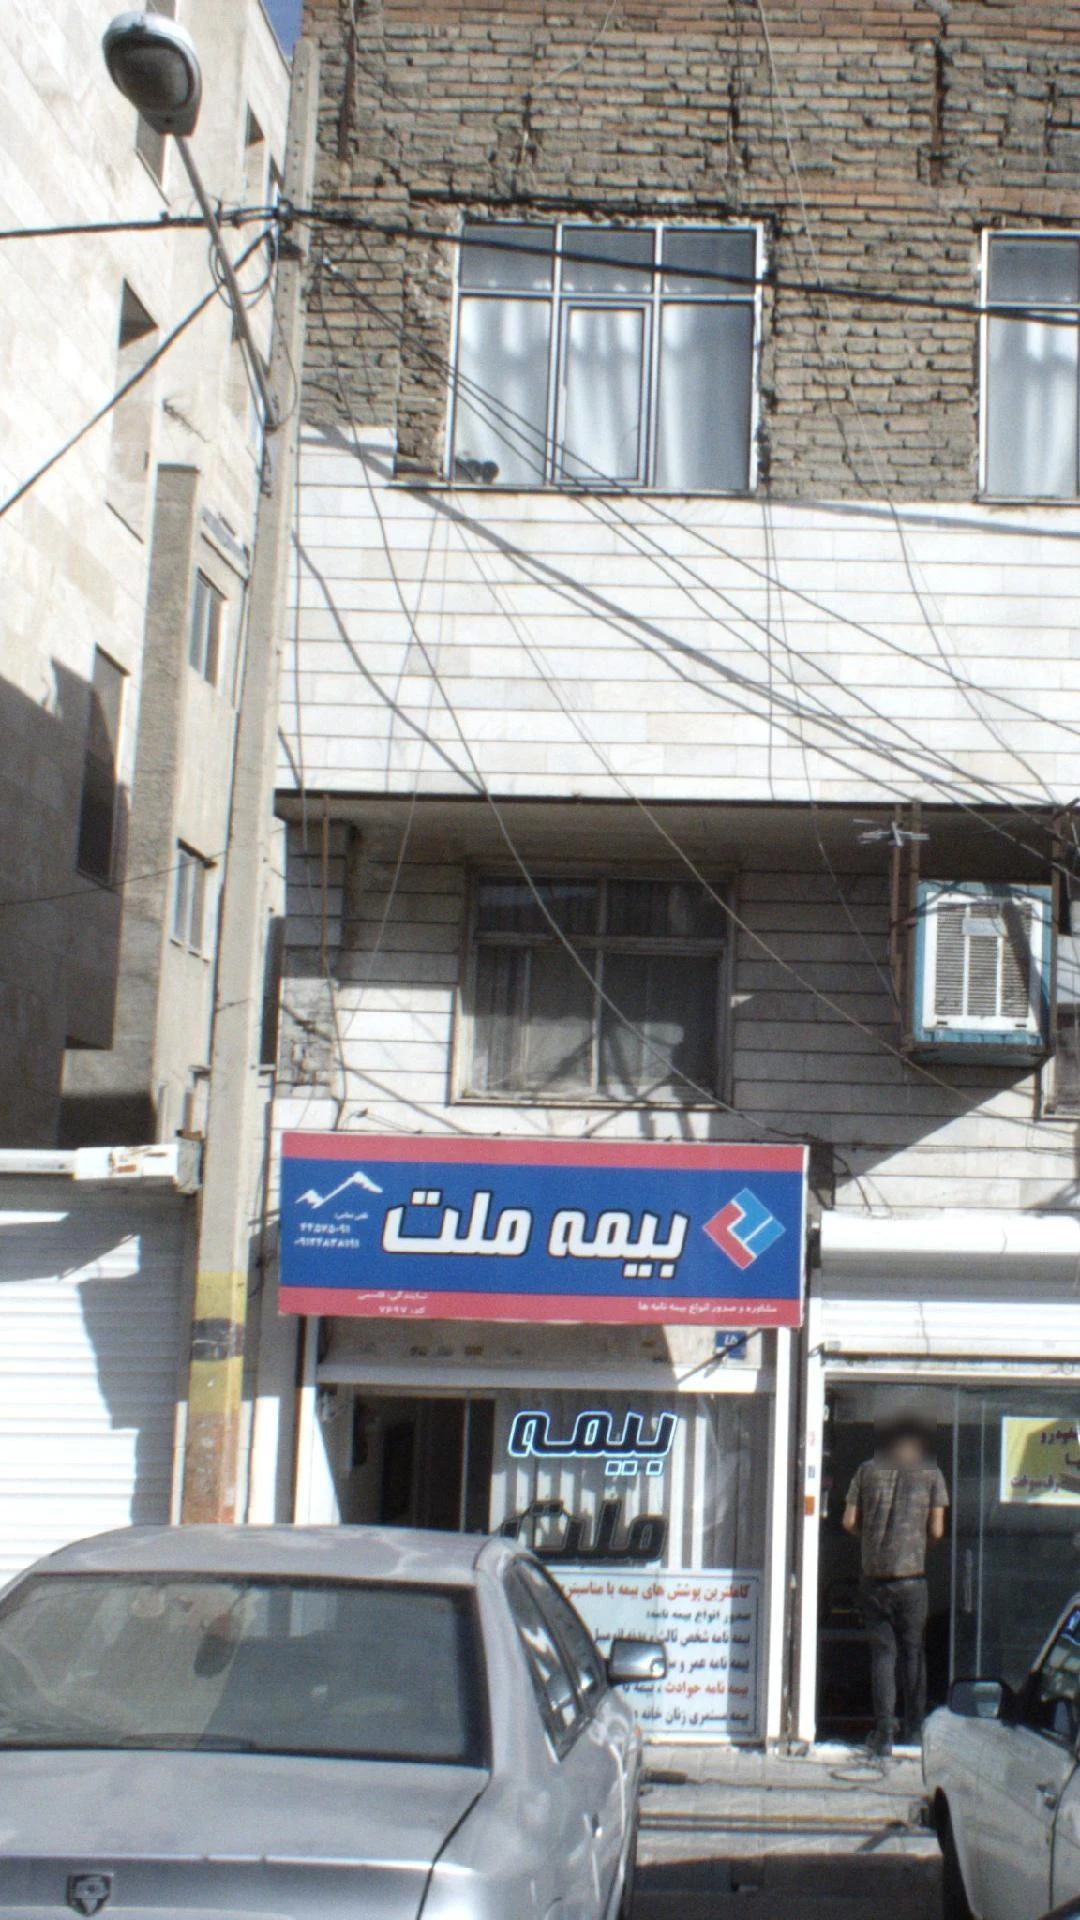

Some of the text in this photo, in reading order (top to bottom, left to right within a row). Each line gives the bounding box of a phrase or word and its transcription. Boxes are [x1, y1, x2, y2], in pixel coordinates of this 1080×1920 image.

[382, 1190, 688, 1279] بیمه ملت
[508, 1410, 678, 1476] بیمه
[618, 1584, 639, 1599] بیمه
